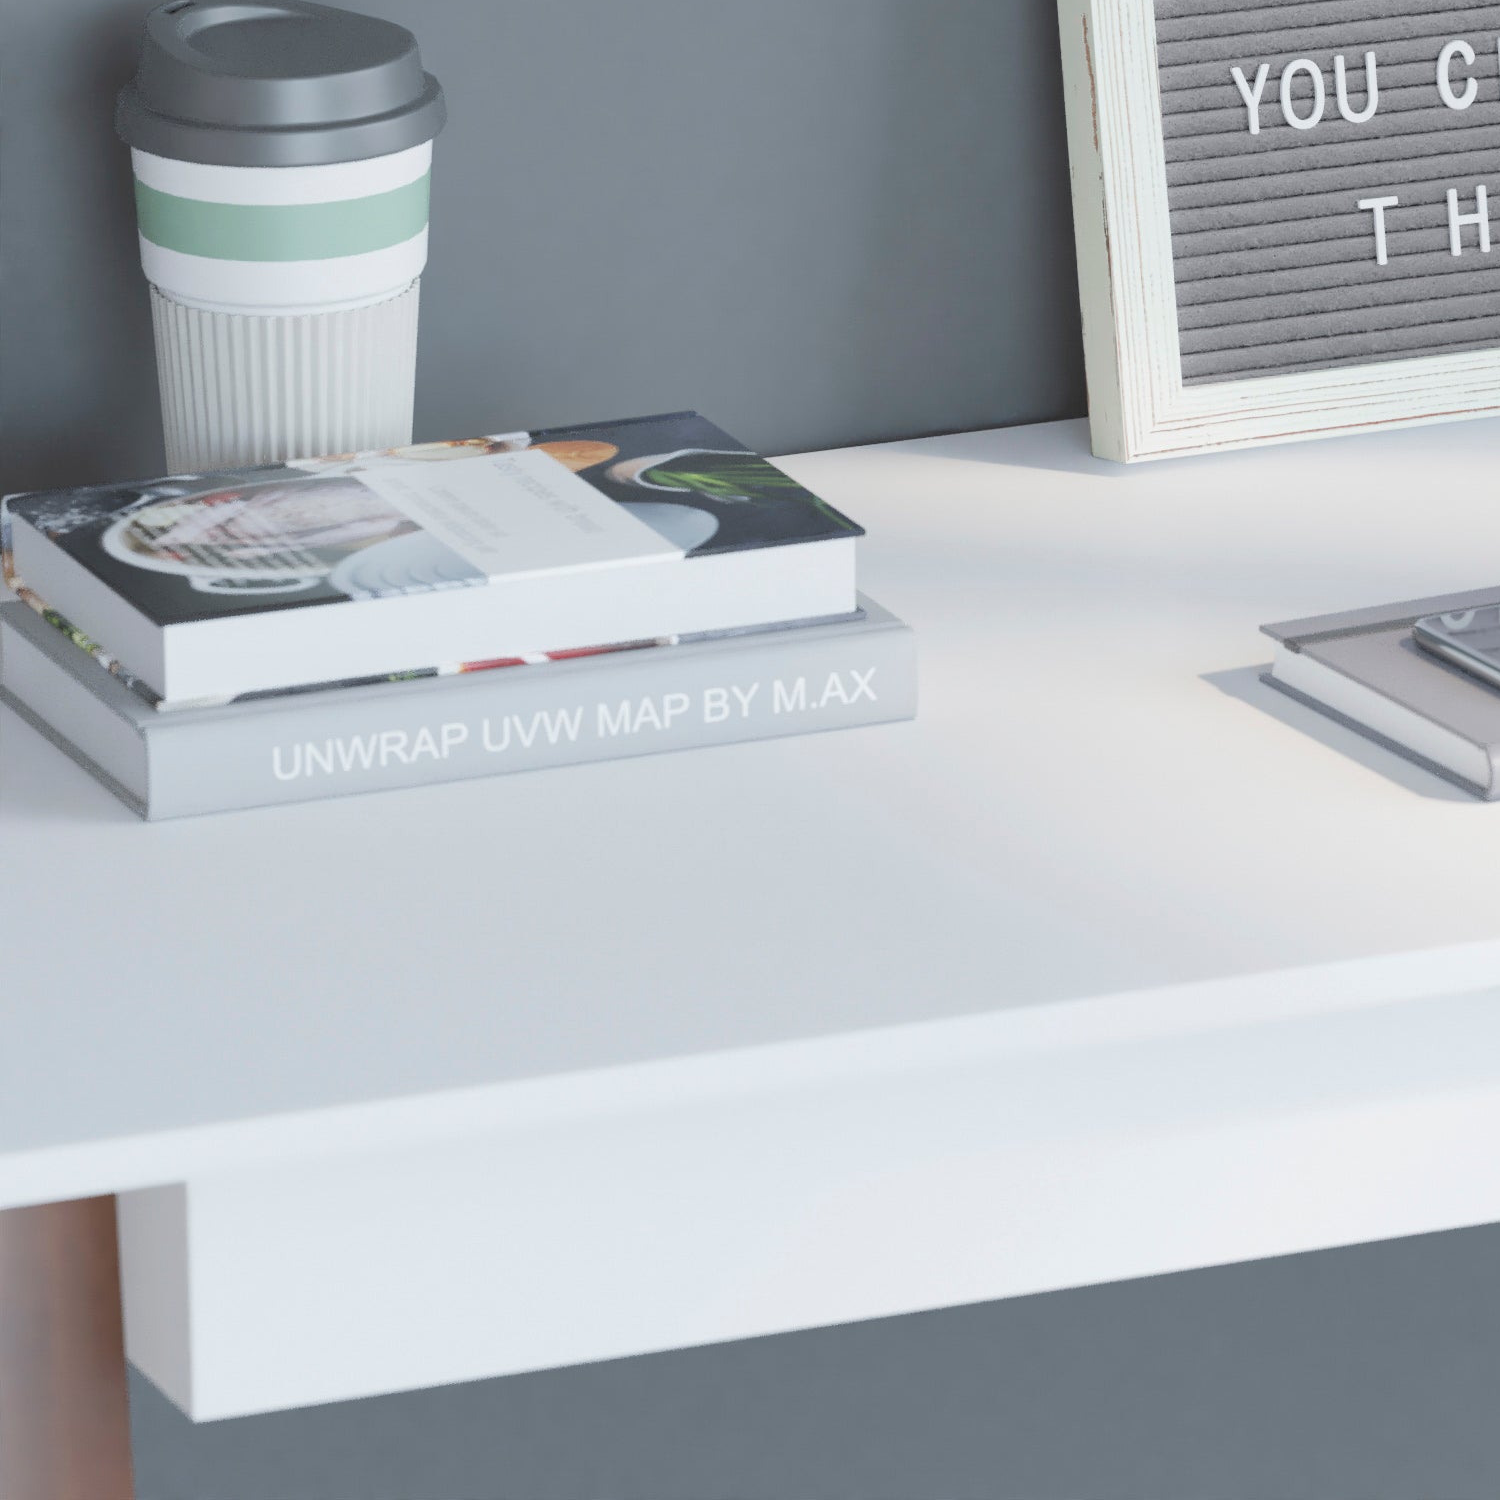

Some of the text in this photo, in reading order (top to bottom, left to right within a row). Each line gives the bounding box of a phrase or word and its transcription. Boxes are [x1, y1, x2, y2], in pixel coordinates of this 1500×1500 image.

[1229, 51, 1379, 135] YOU
[272, 666, 879, 781] UNWRAP UVW MAP BY M.AX
